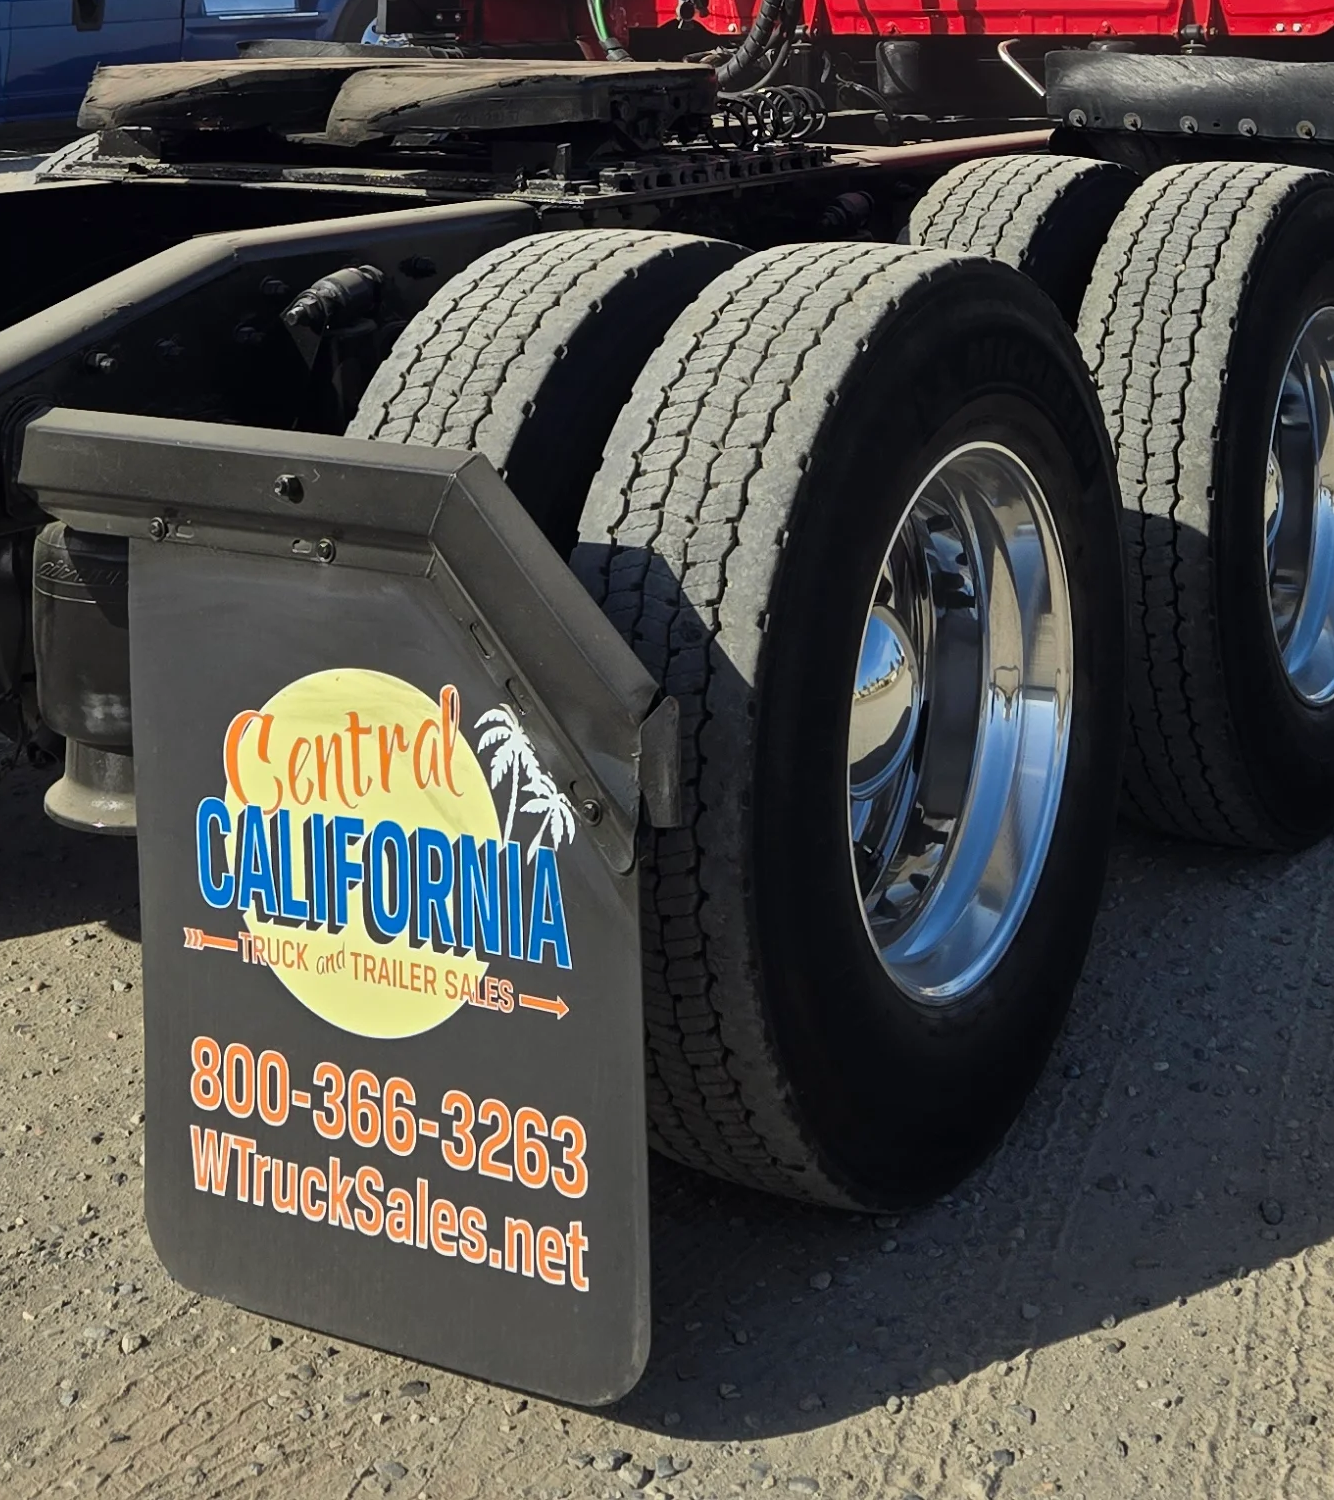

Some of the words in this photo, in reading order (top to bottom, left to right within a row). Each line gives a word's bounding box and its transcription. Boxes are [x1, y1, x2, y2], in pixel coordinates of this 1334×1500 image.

[223, 683, 465, 815] Central
[196, 795, 573, 970] CALIFORNIA
[237, 930, 310, 973] TRUCK
[315, 940, 347, 976] and
[350, 950, 438, 997] TRAILER
[444, 970, 515, 1014] SALES
[190, 1035, 589, 1199] 800-366-3263
[190, 1124, 590, 1293] WTruckSales.net
